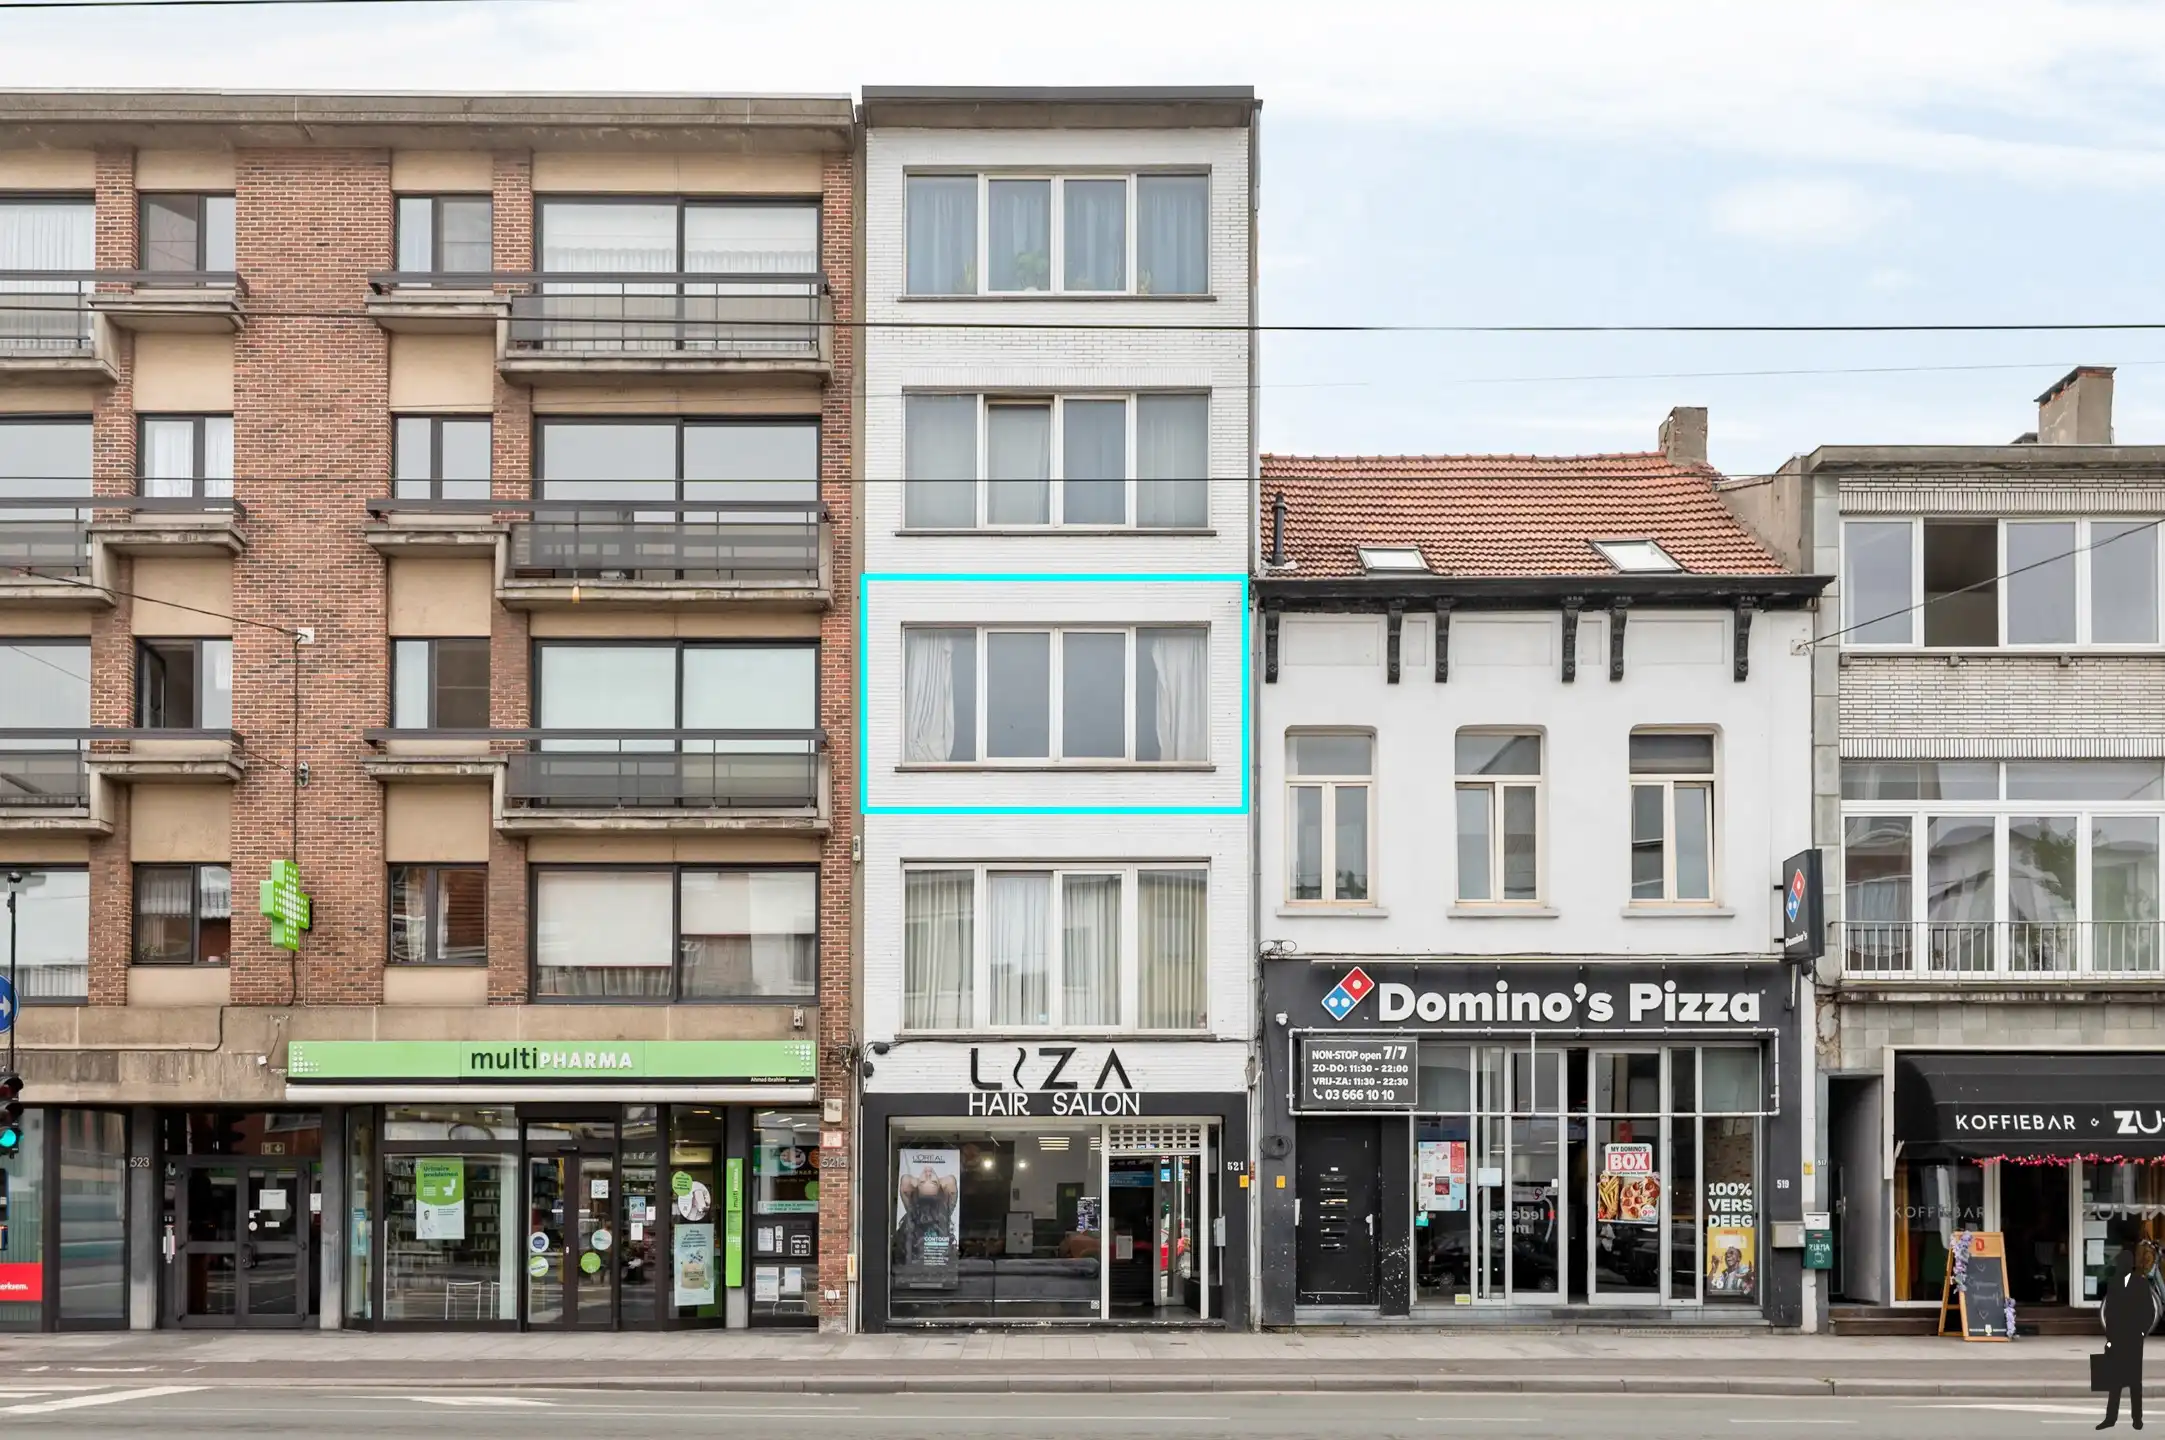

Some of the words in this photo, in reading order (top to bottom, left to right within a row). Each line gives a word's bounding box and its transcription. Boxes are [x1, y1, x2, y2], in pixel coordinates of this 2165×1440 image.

[1379, 980, 1614, 1022] Domino's
[1629, 980, 1760, 1022] Pizza
[1312, 1050, 1359, 1060] NON-STOP
[1360, 1052, 1382, 1062] open
[1383, 1045, 1408, 1060] 7/7
[970, 1047, 1133, 1090] LIZA
[1312, 1064, 1348, 1073] ZO-DO:
[1349, 1064, 1373, 1073] 11:30
[1381, 1064, 1409, 1073] 22:00
[1312, 1077, 1352, 1086] VRIJ-ZA:
[1353, 1077, 1375, 1086] 11:30
[1382, 1077, 1409, 1086] 22:30
[1325, 1089, 1340, 1100] 03
[1342, 1089, 1364, 1100] 666
[1366, 1089, 1379, 1100] 10
[1381, 1089, 1395, 1100] 10
[969, 1092, 1030, 1116] HAIR
[1052, 1092, 1140, 1116] SALON
[1956, 1114, 2076, 1130] KOFFIEBAR
[2113, 1110, 2165, 1134] ZU
[130, 1157, 150, 1168] 523
[1227, 1161, 1244, 1171] 521
[1610, 1153, 1648, 1170] BOX
[1708, 1182, 1752, 1196] 100%
[1708, 1198, 1753, 1212] VERS
[1708, 1214, 1753, 1228] DEEG
